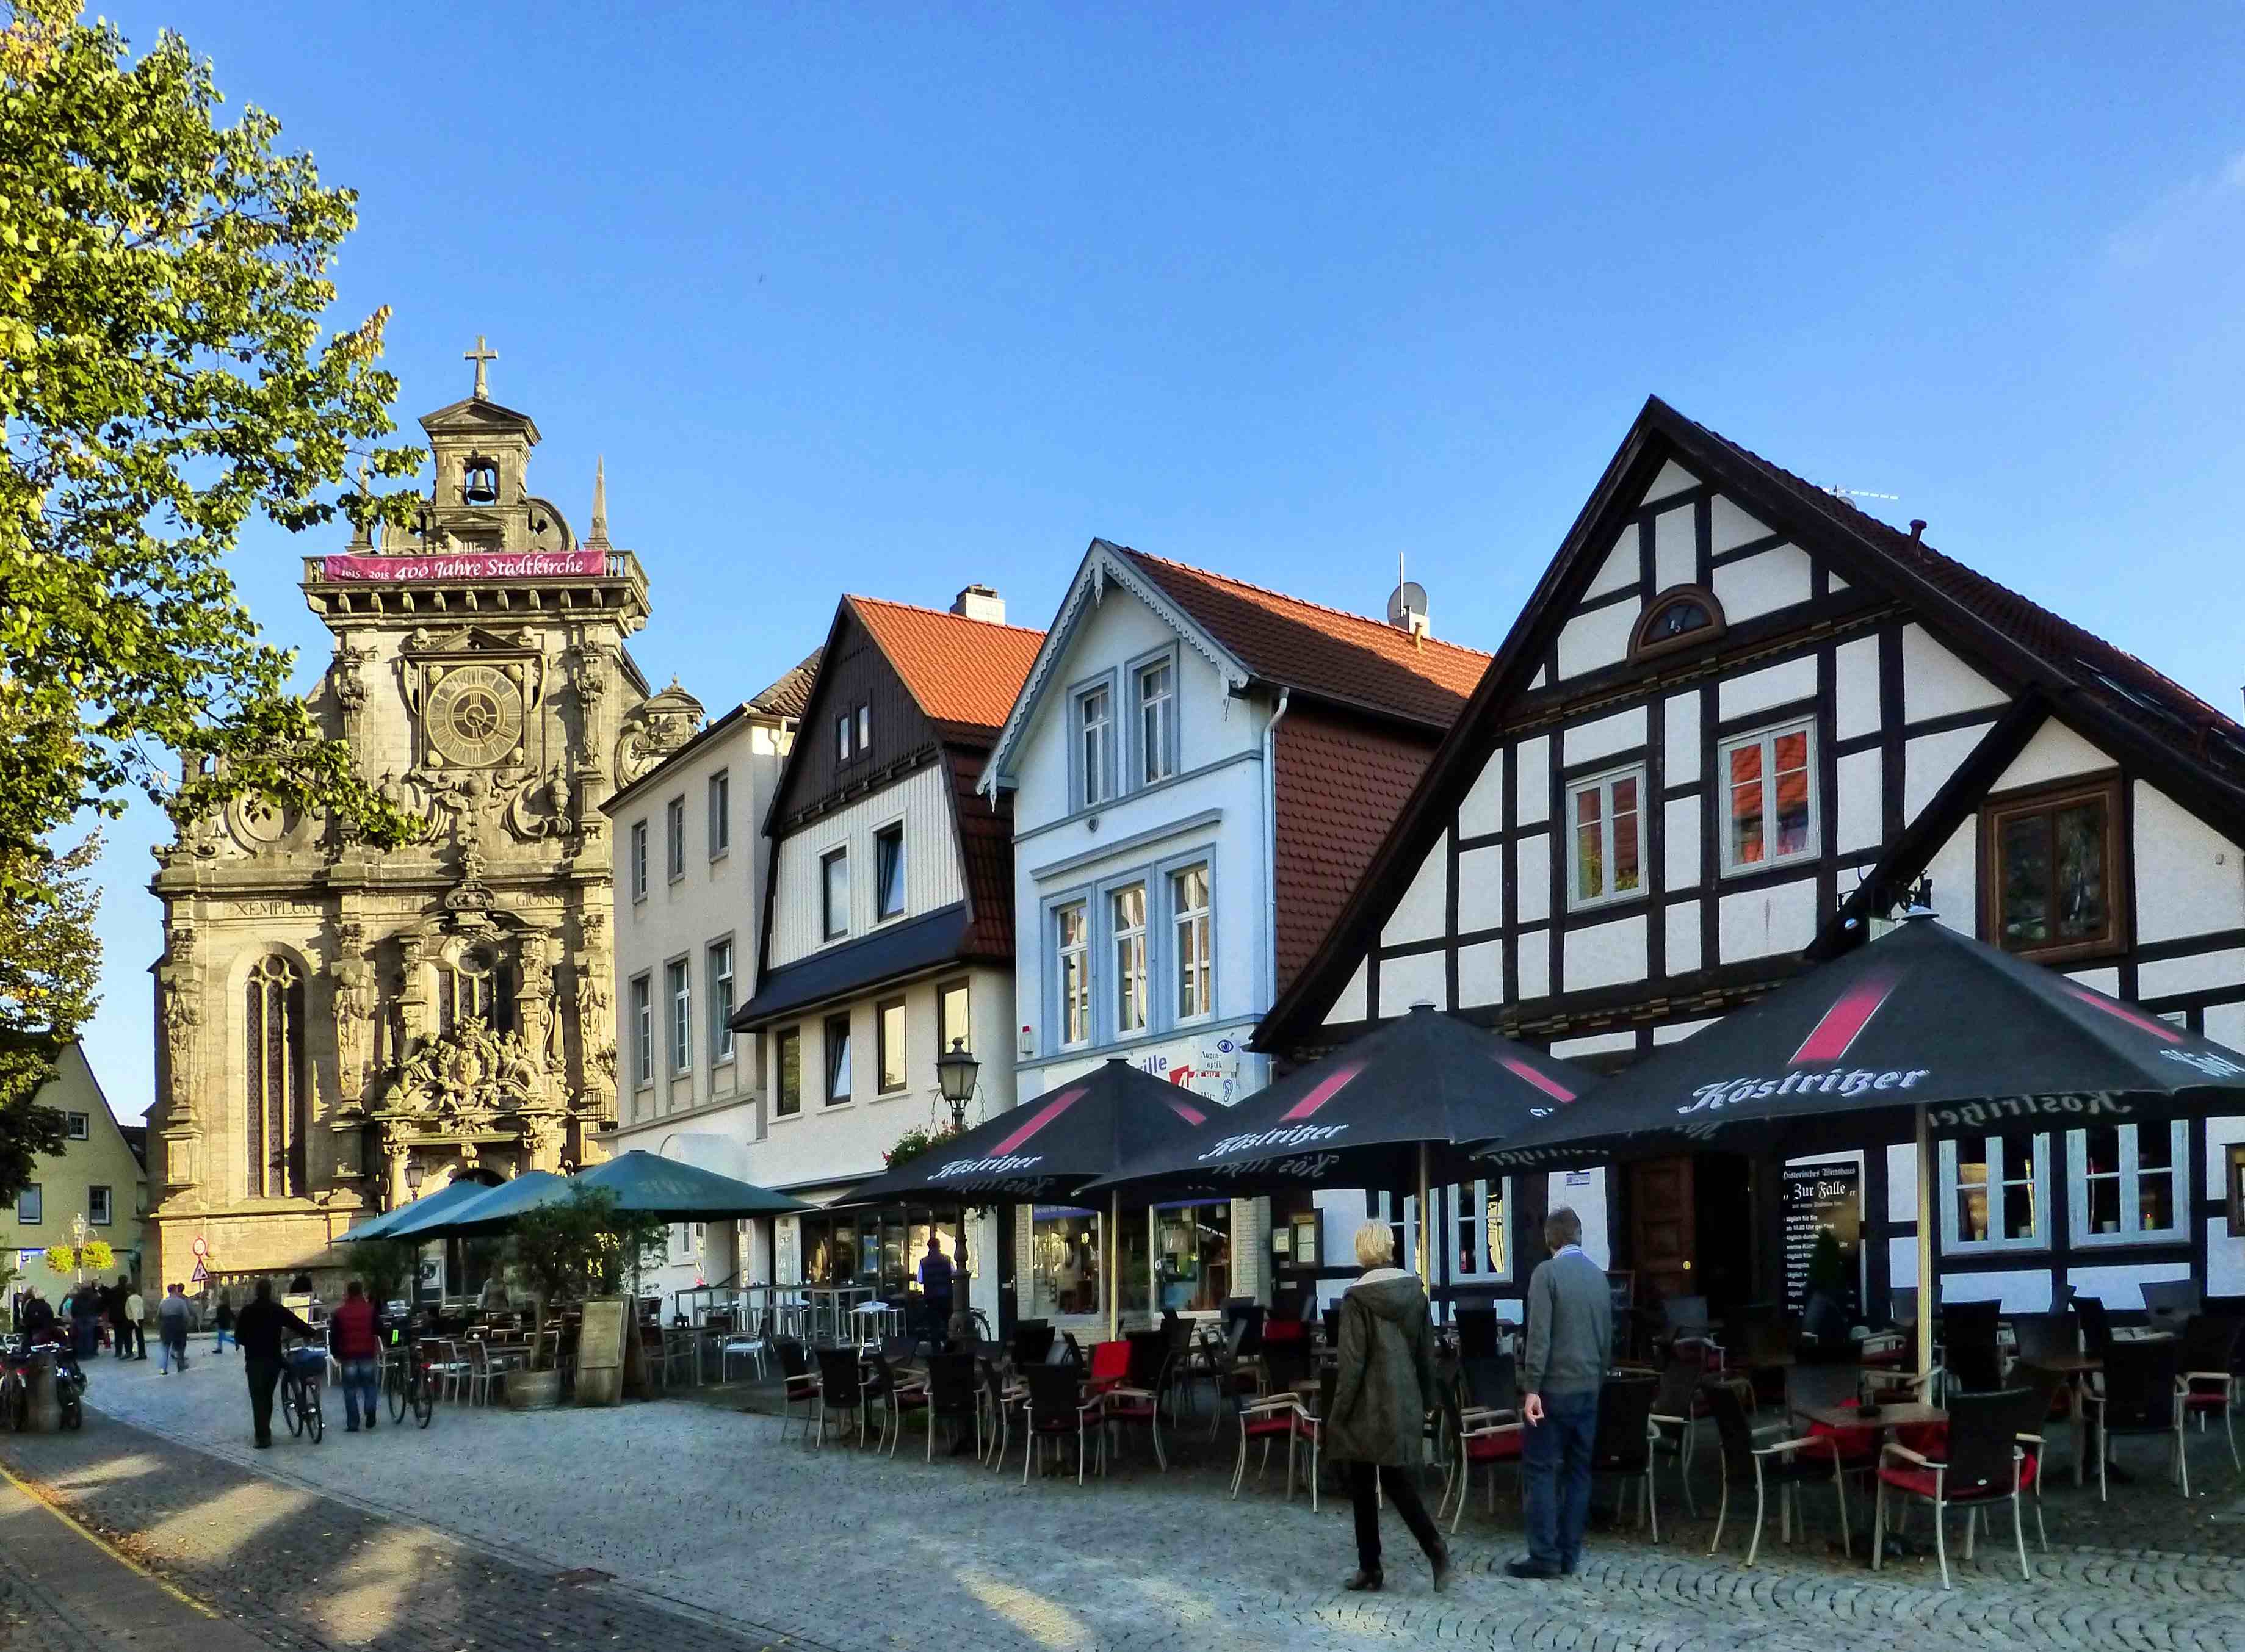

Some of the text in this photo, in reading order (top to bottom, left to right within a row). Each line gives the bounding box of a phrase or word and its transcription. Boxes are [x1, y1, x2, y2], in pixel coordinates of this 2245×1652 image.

[341, 569, 361, 578] 1615
[368, 571, 391, 580] 2015
[394, 566, 429, 580] 400
[431, 559, 482, 579] Jahre
[486, 554, 584, 576] Stadtkirche
[228, 901, 318, 916] XEMPLUM
[1207, 1061, 1222, 1069] optik
[1676, 1068, 1931, 1114] Köstritzer
[1196, 1123, 1350, 1161] Köstritzer
[927, 1154, 1043, 1181] Köstritzer
[1793, 1183, 1815, 1200] Zur
[1817, 1181, 1846, 1199] Falle
